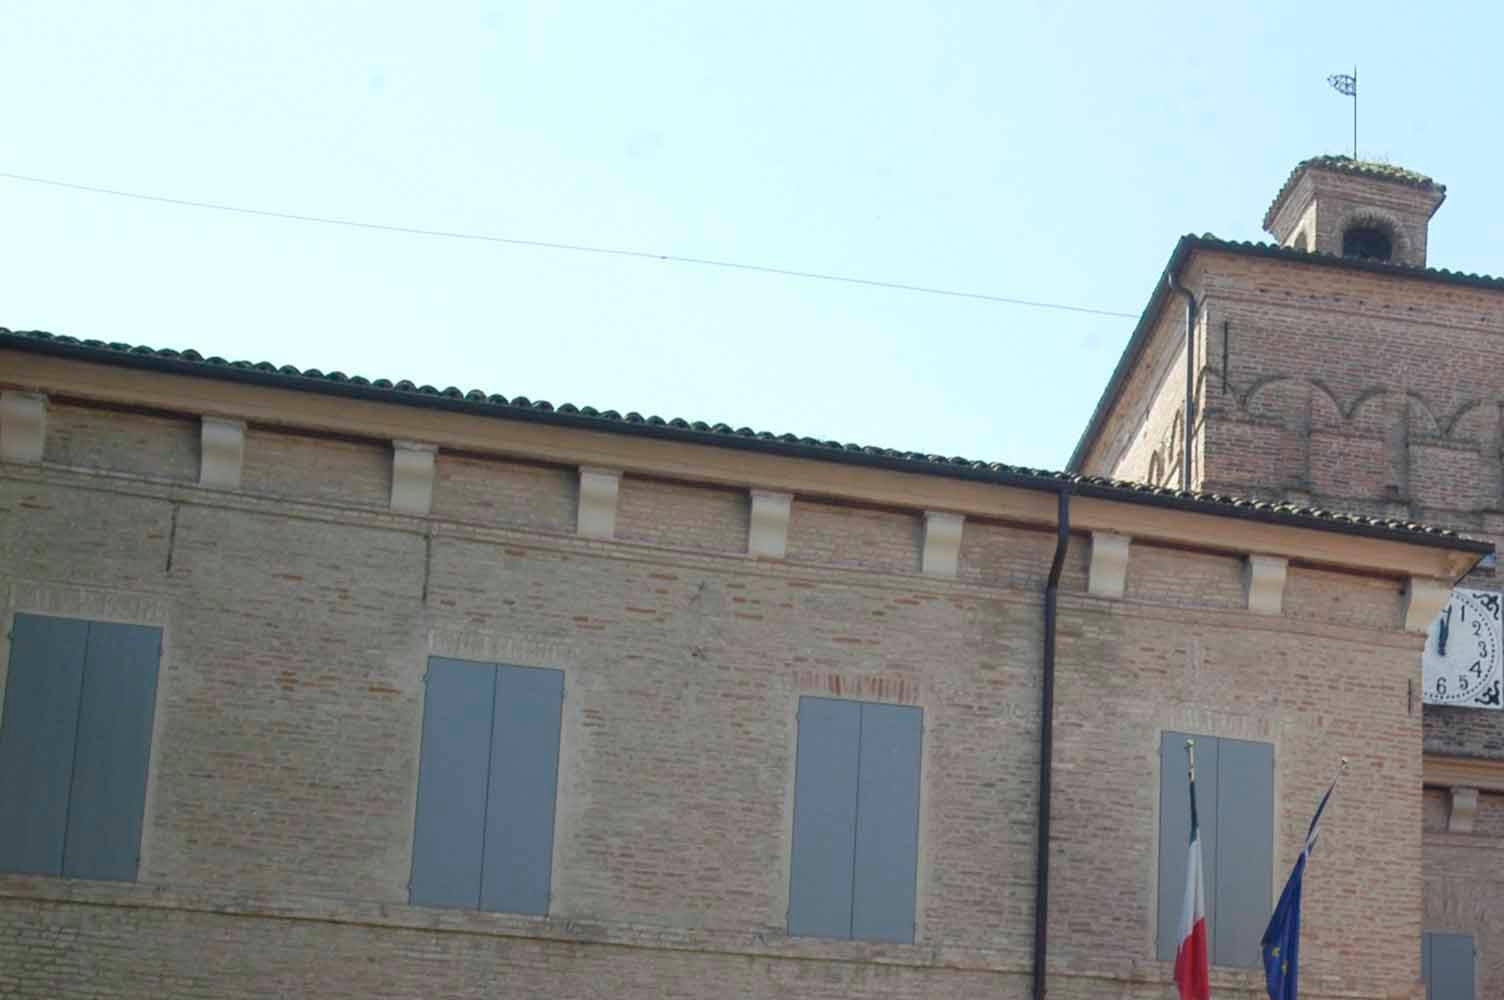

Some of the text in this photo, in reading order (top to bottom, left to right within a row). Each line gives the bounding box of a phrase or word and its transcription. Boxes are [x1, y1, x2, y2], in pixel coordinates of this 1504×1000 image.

[1472, 620, 1481, 636] 2
[1478, 641, 1487, 658] 3
[1468, 661, 1481, 678] 4
[1436, 677, 1447, 695] 6
[1459, 675, 1469, 690] 5
